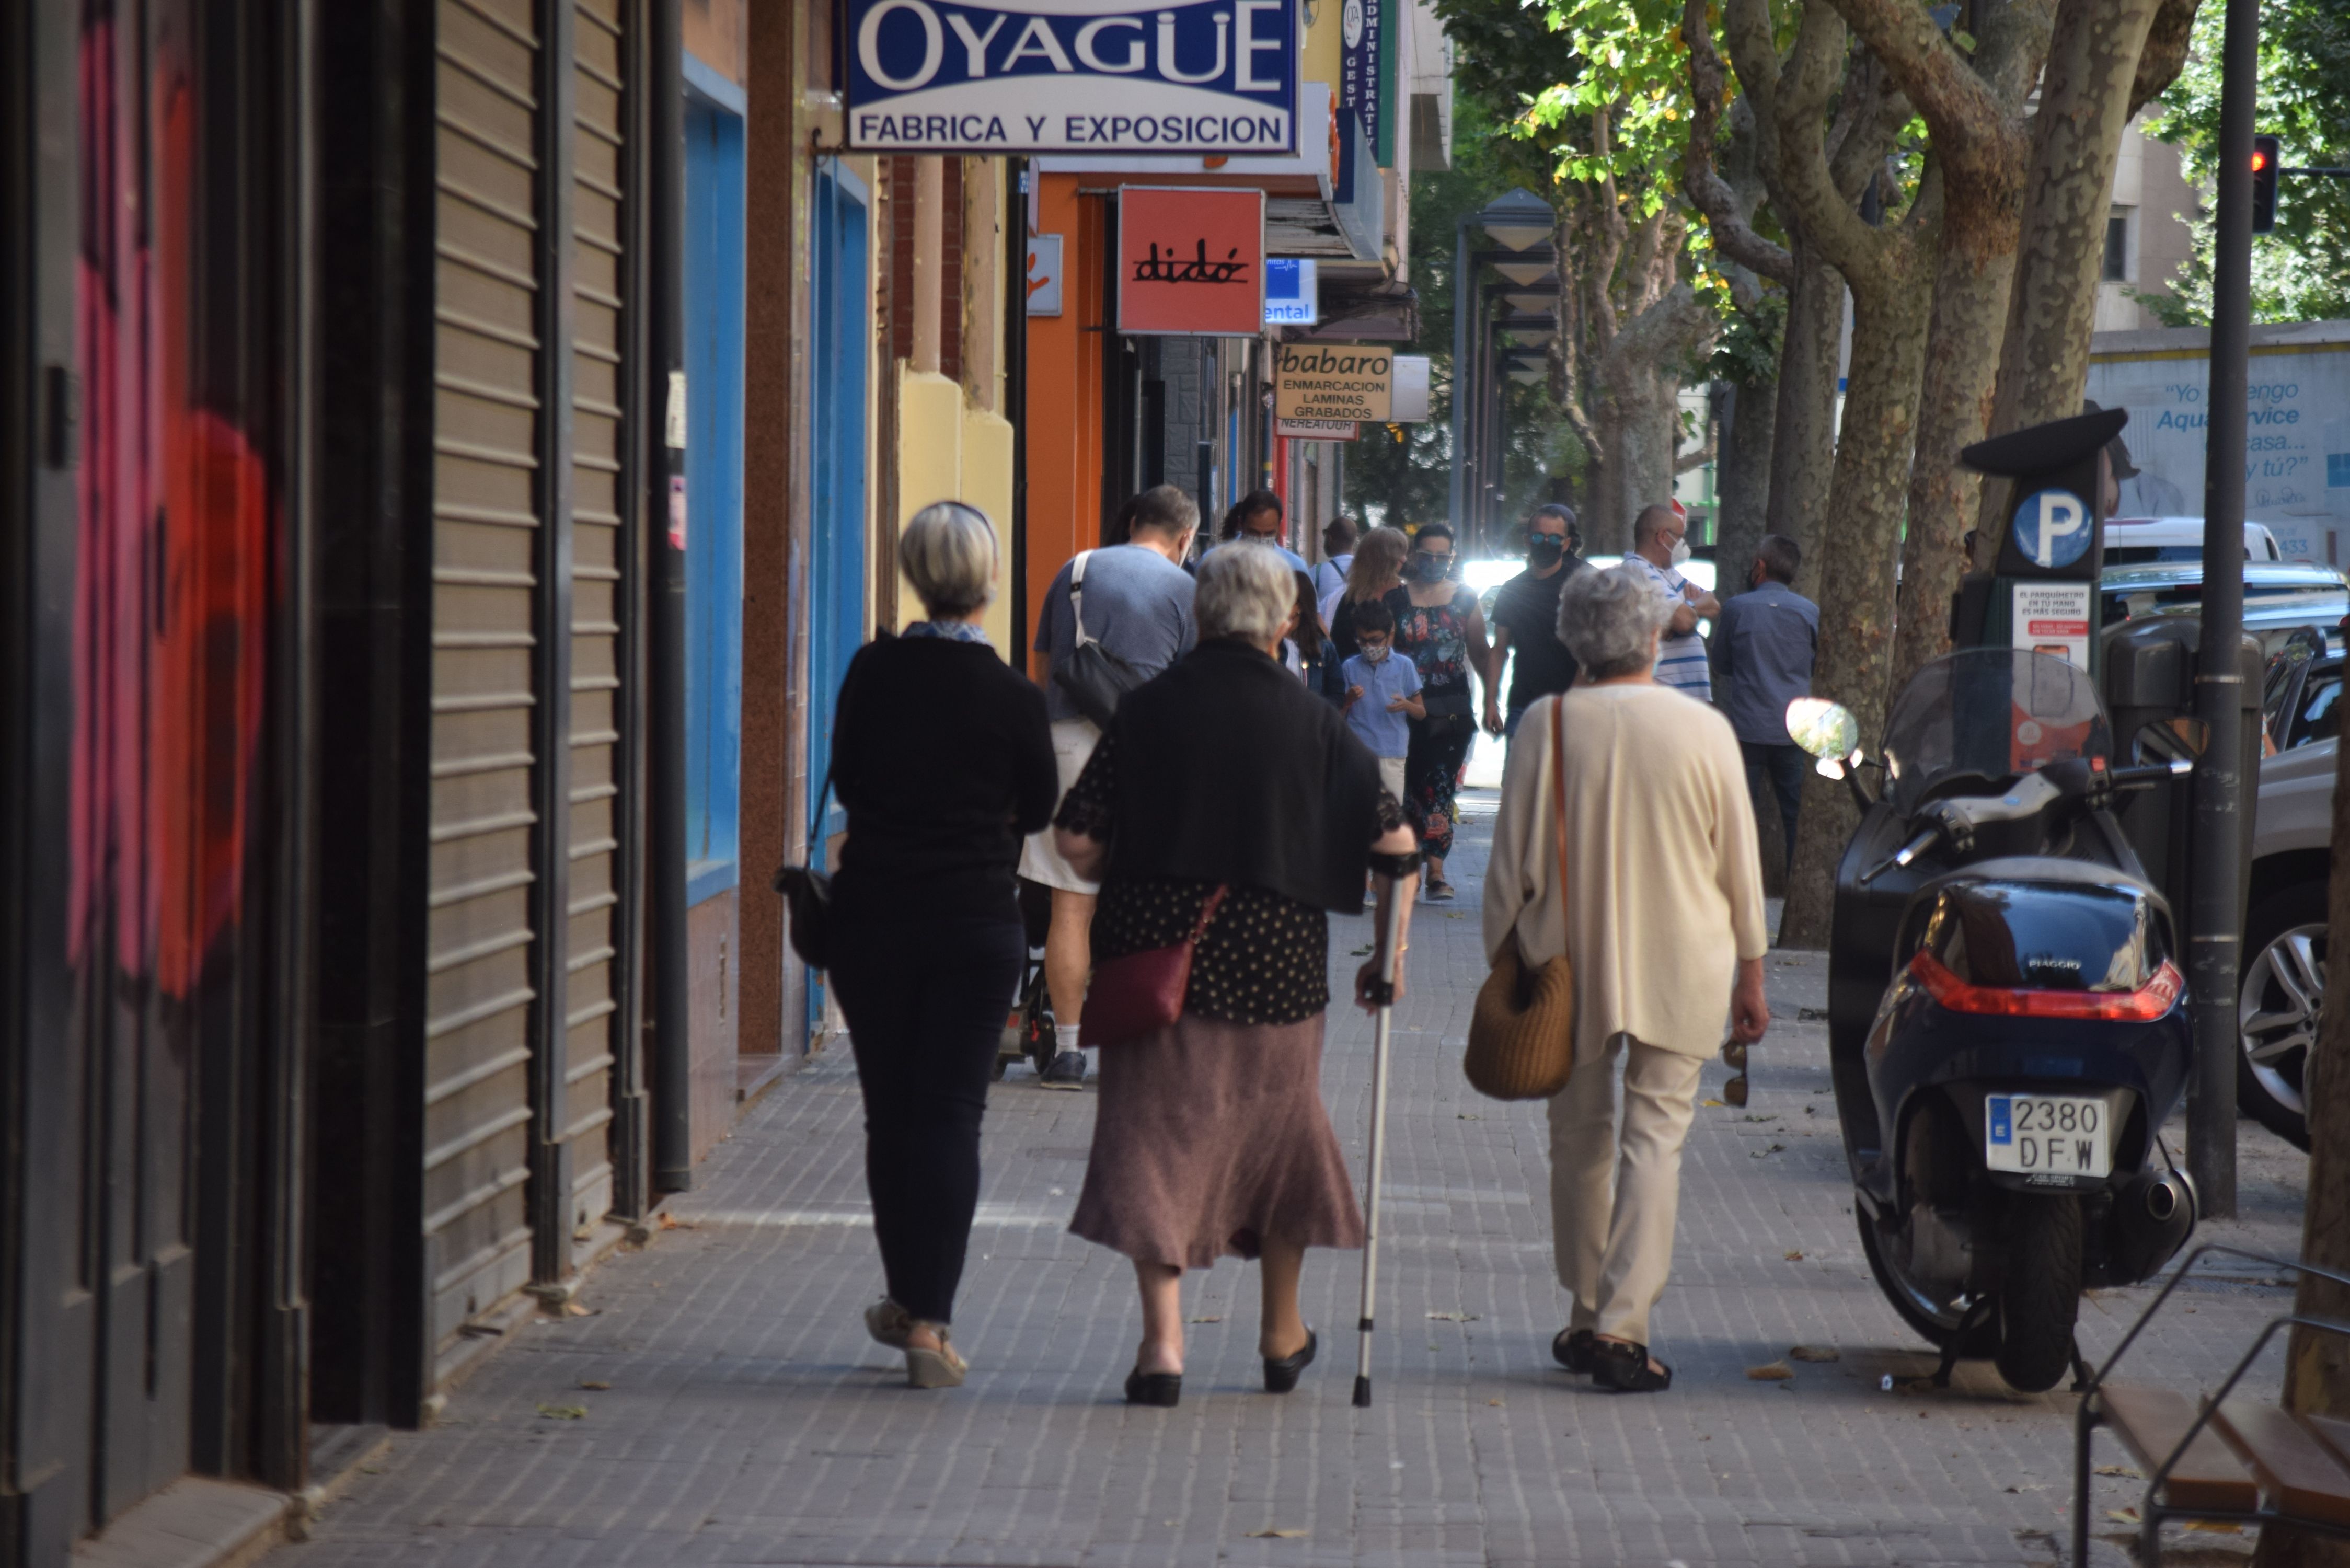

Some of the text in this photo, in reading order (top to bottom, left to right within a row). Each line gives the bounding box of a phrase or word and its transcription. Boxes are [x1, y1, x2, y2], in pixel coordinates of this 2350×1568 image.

[1346, 56, 1356, 108] GEST
[860, 115, 1281, 143] FABRICA Y EXPOSICION
[1265, 304, 1309, 319] ental
[1282, 347, 1389, 375] babaro
[1283, 380, 1385, 392] ENMARCACION
[2247, 384, 2299, 404] engo
[1303, 394, 1364, 406] LAMINAS
[1294, 407, 1372, 419] GRABADOS
[2038, 494, 2084, 568] P
[2029, 959, 2082, 970] PIAGGIO
[2015, 1101, 2098, 1134] 2380
[1995, 1125, 2005, 1137] E
